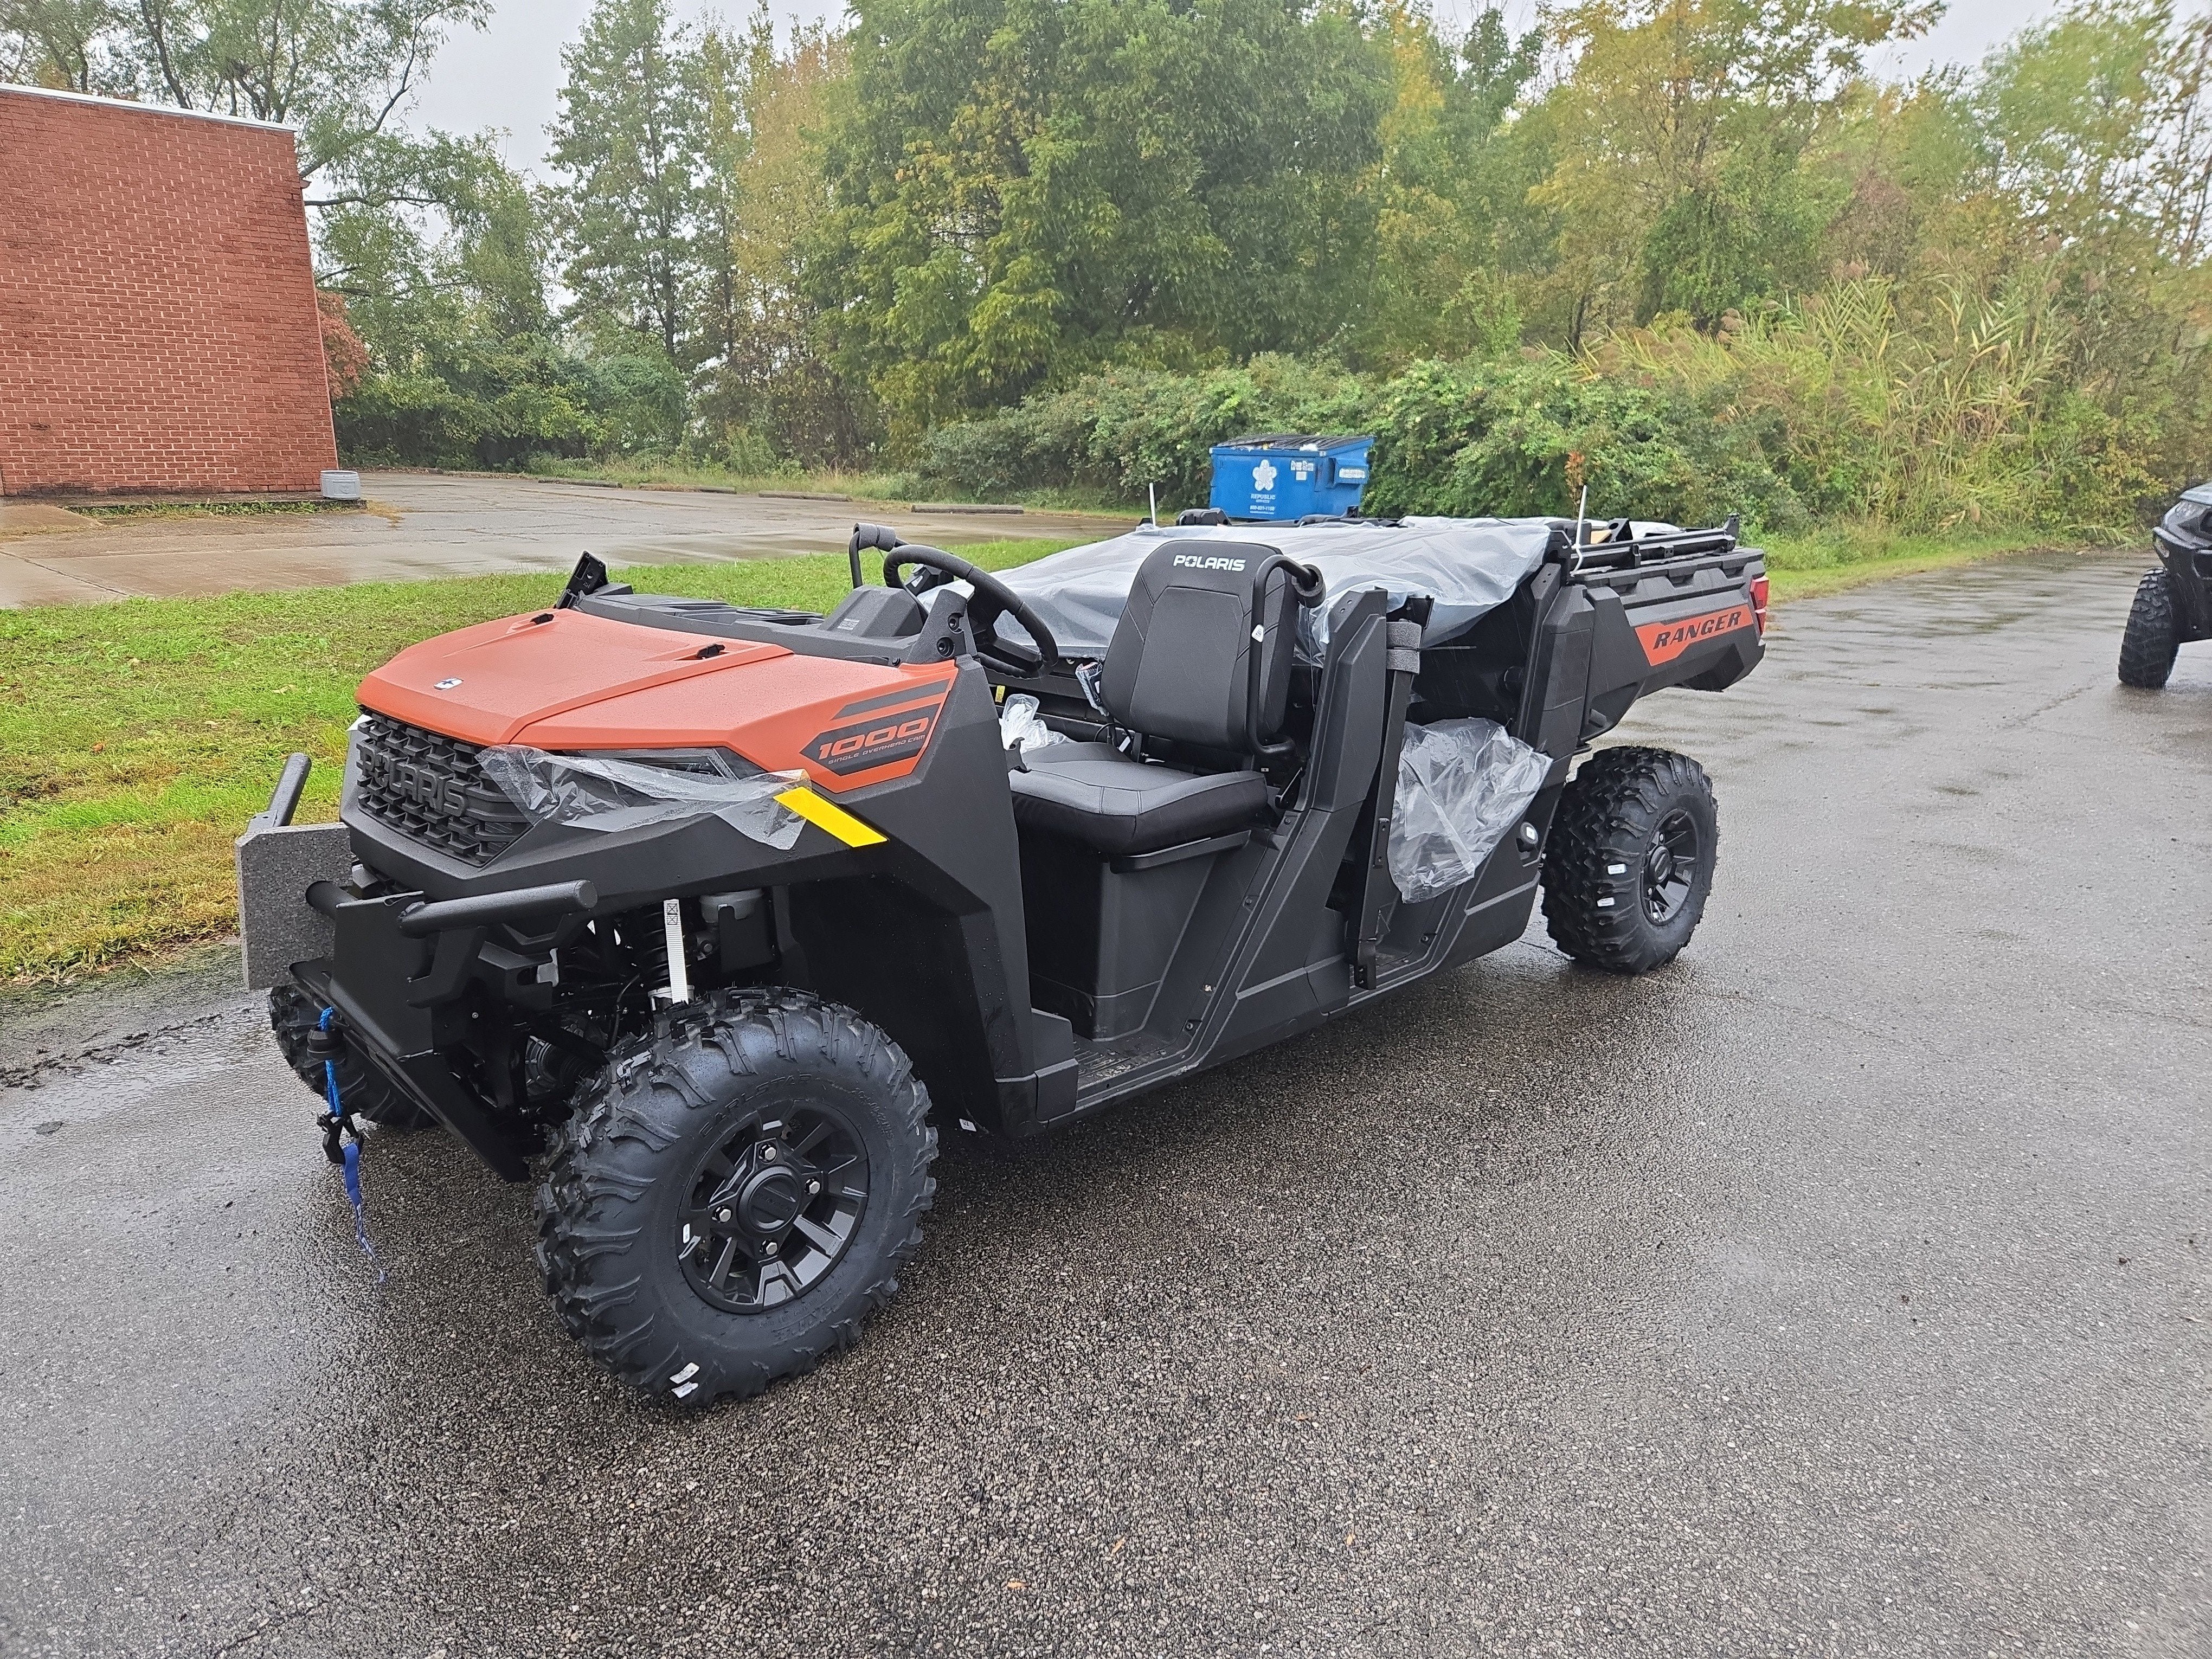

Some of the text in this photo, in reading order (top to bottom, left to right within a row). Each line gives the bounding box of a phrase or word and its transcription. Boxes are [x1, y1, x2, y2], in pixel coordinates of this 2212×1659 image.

[1173, 555, 1246, 571] POLARIS
[1652, 611, 1741, 650] RANGER
[818, 717, 929, 760] 1000
[828, 734, 925, 764] SINGLE OVERHEAD CAM
[359, 745, 465, 817] POLARIS
